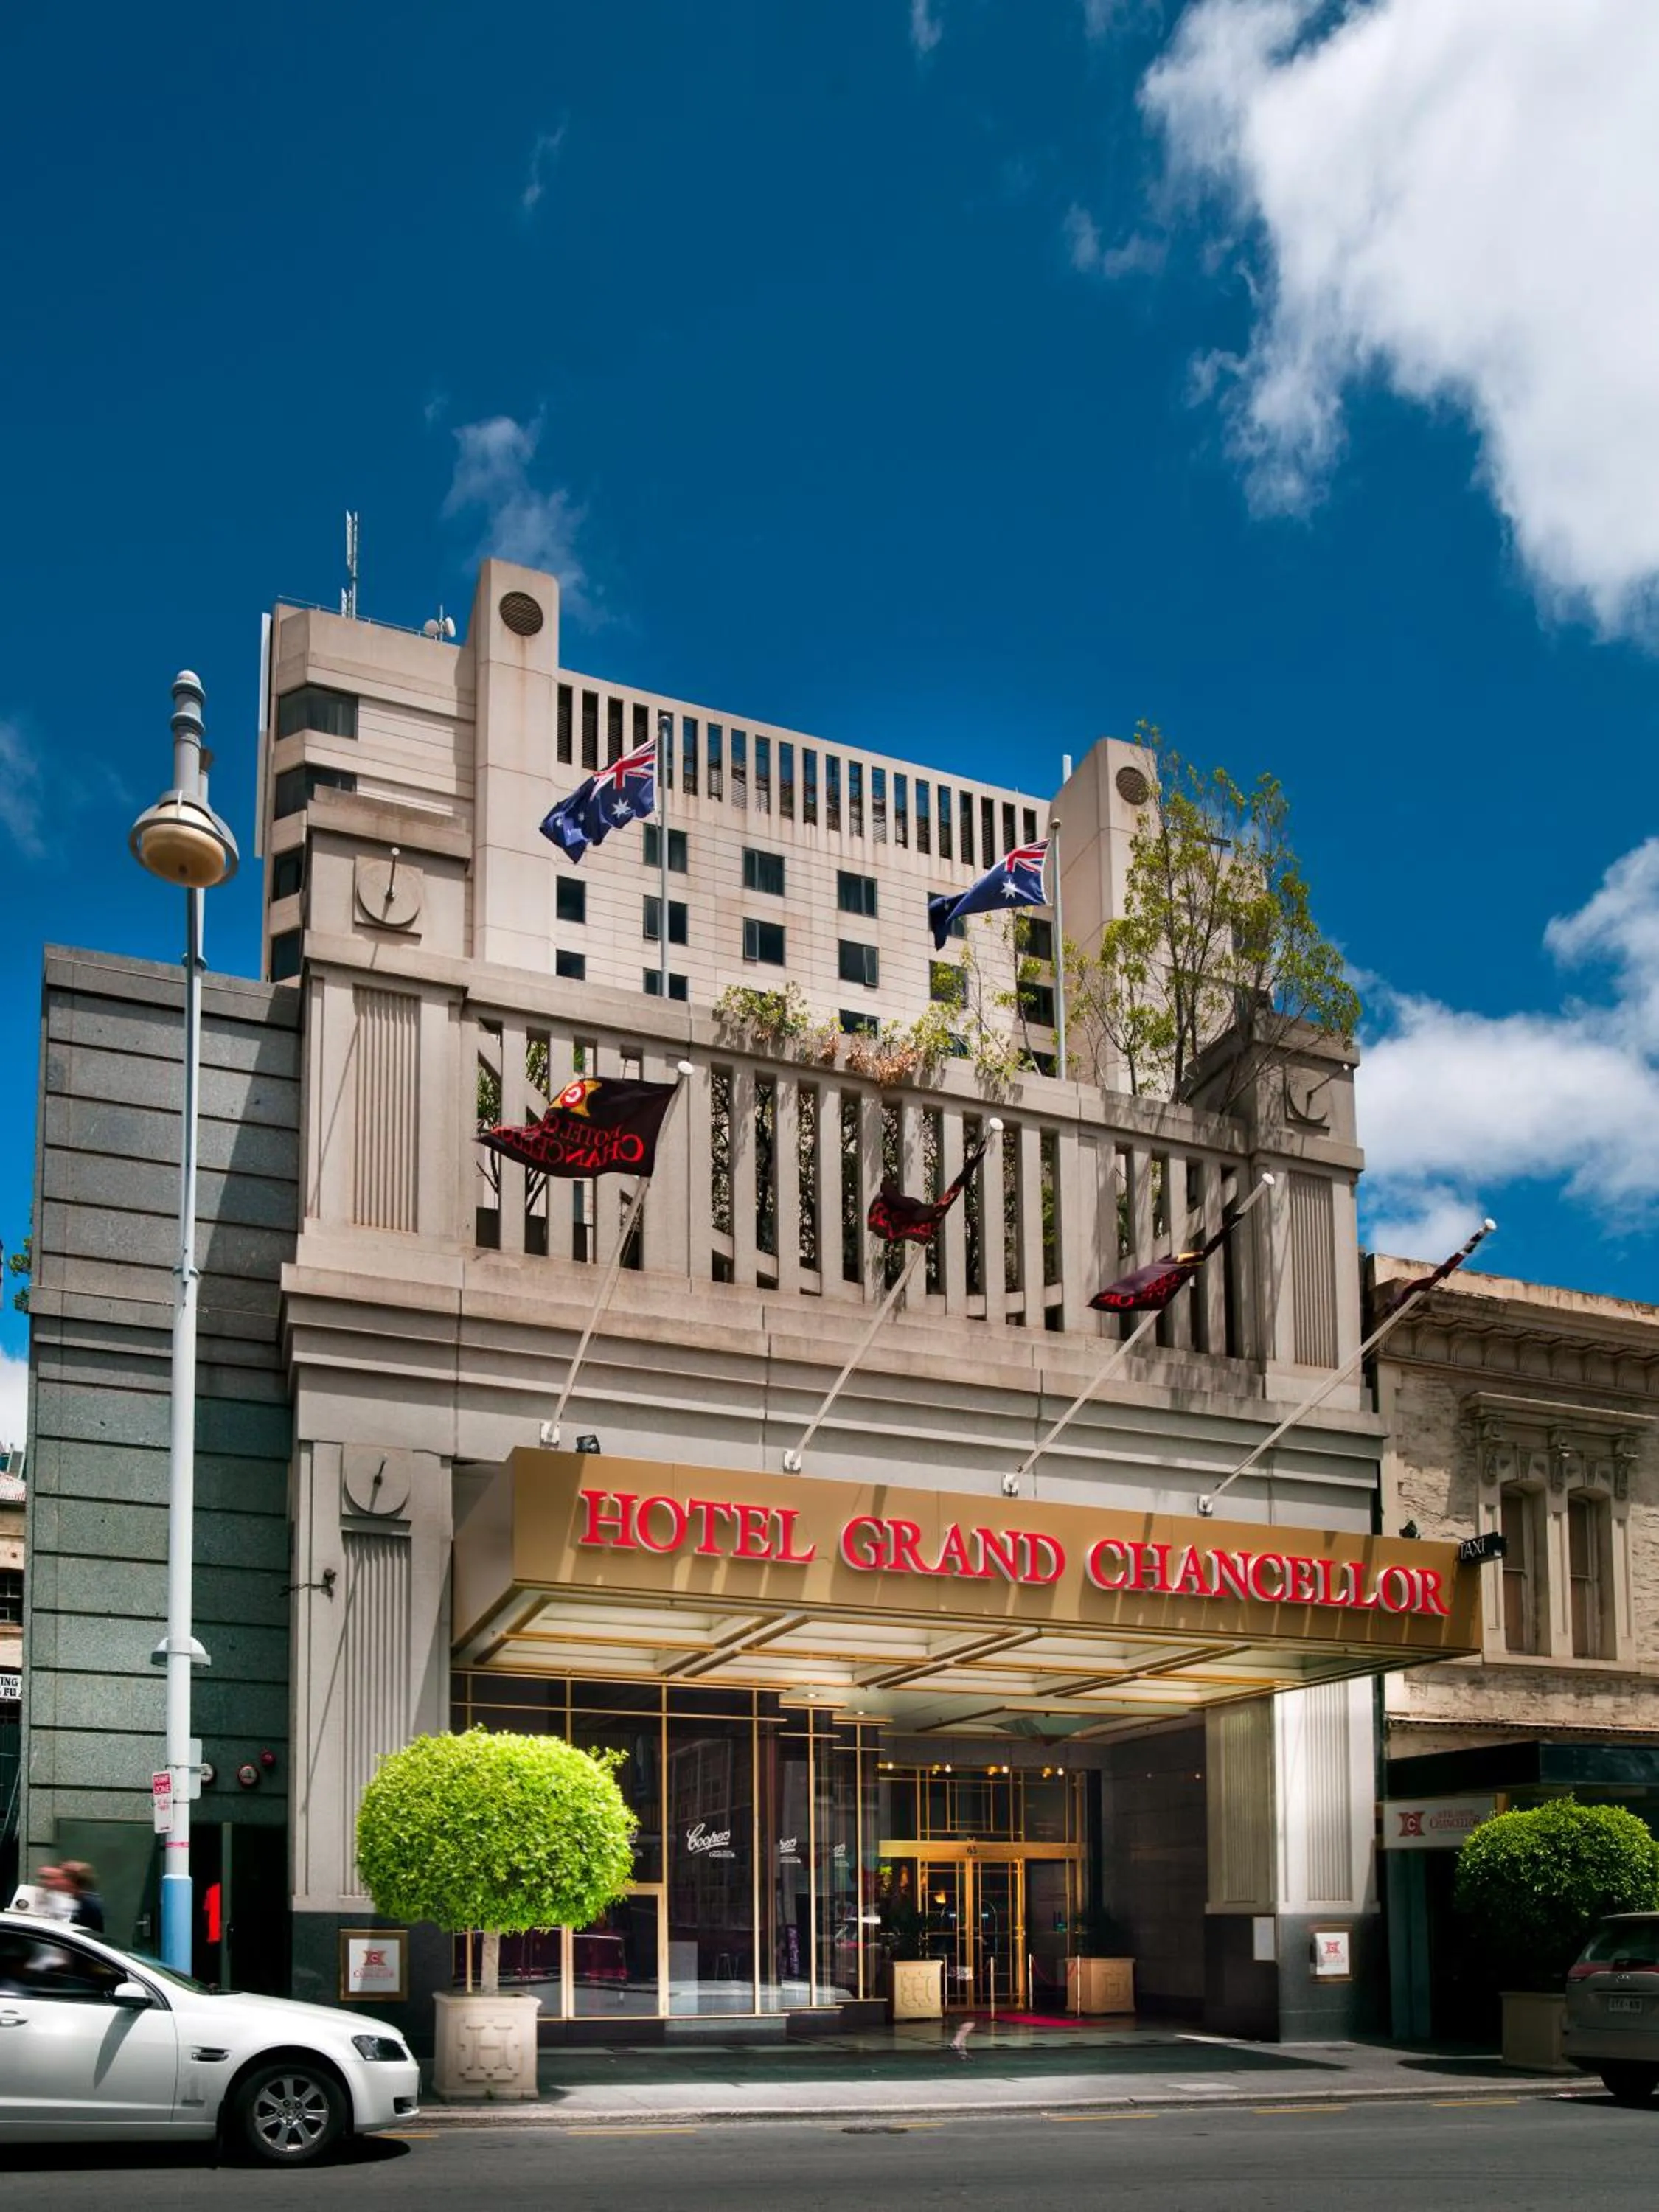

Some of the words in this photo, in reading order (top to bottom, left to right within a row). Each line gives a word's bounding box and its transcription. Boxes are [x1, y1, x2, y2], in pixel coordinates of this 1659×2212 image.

[578, 1489, 816, 1565] HOTEL
[839, 1516, 1066, 1585] GRAND
[1085, 1538, 1451, 1616] CHANCELLOR
[1460, 1537, 1486, 1559] TAXI
